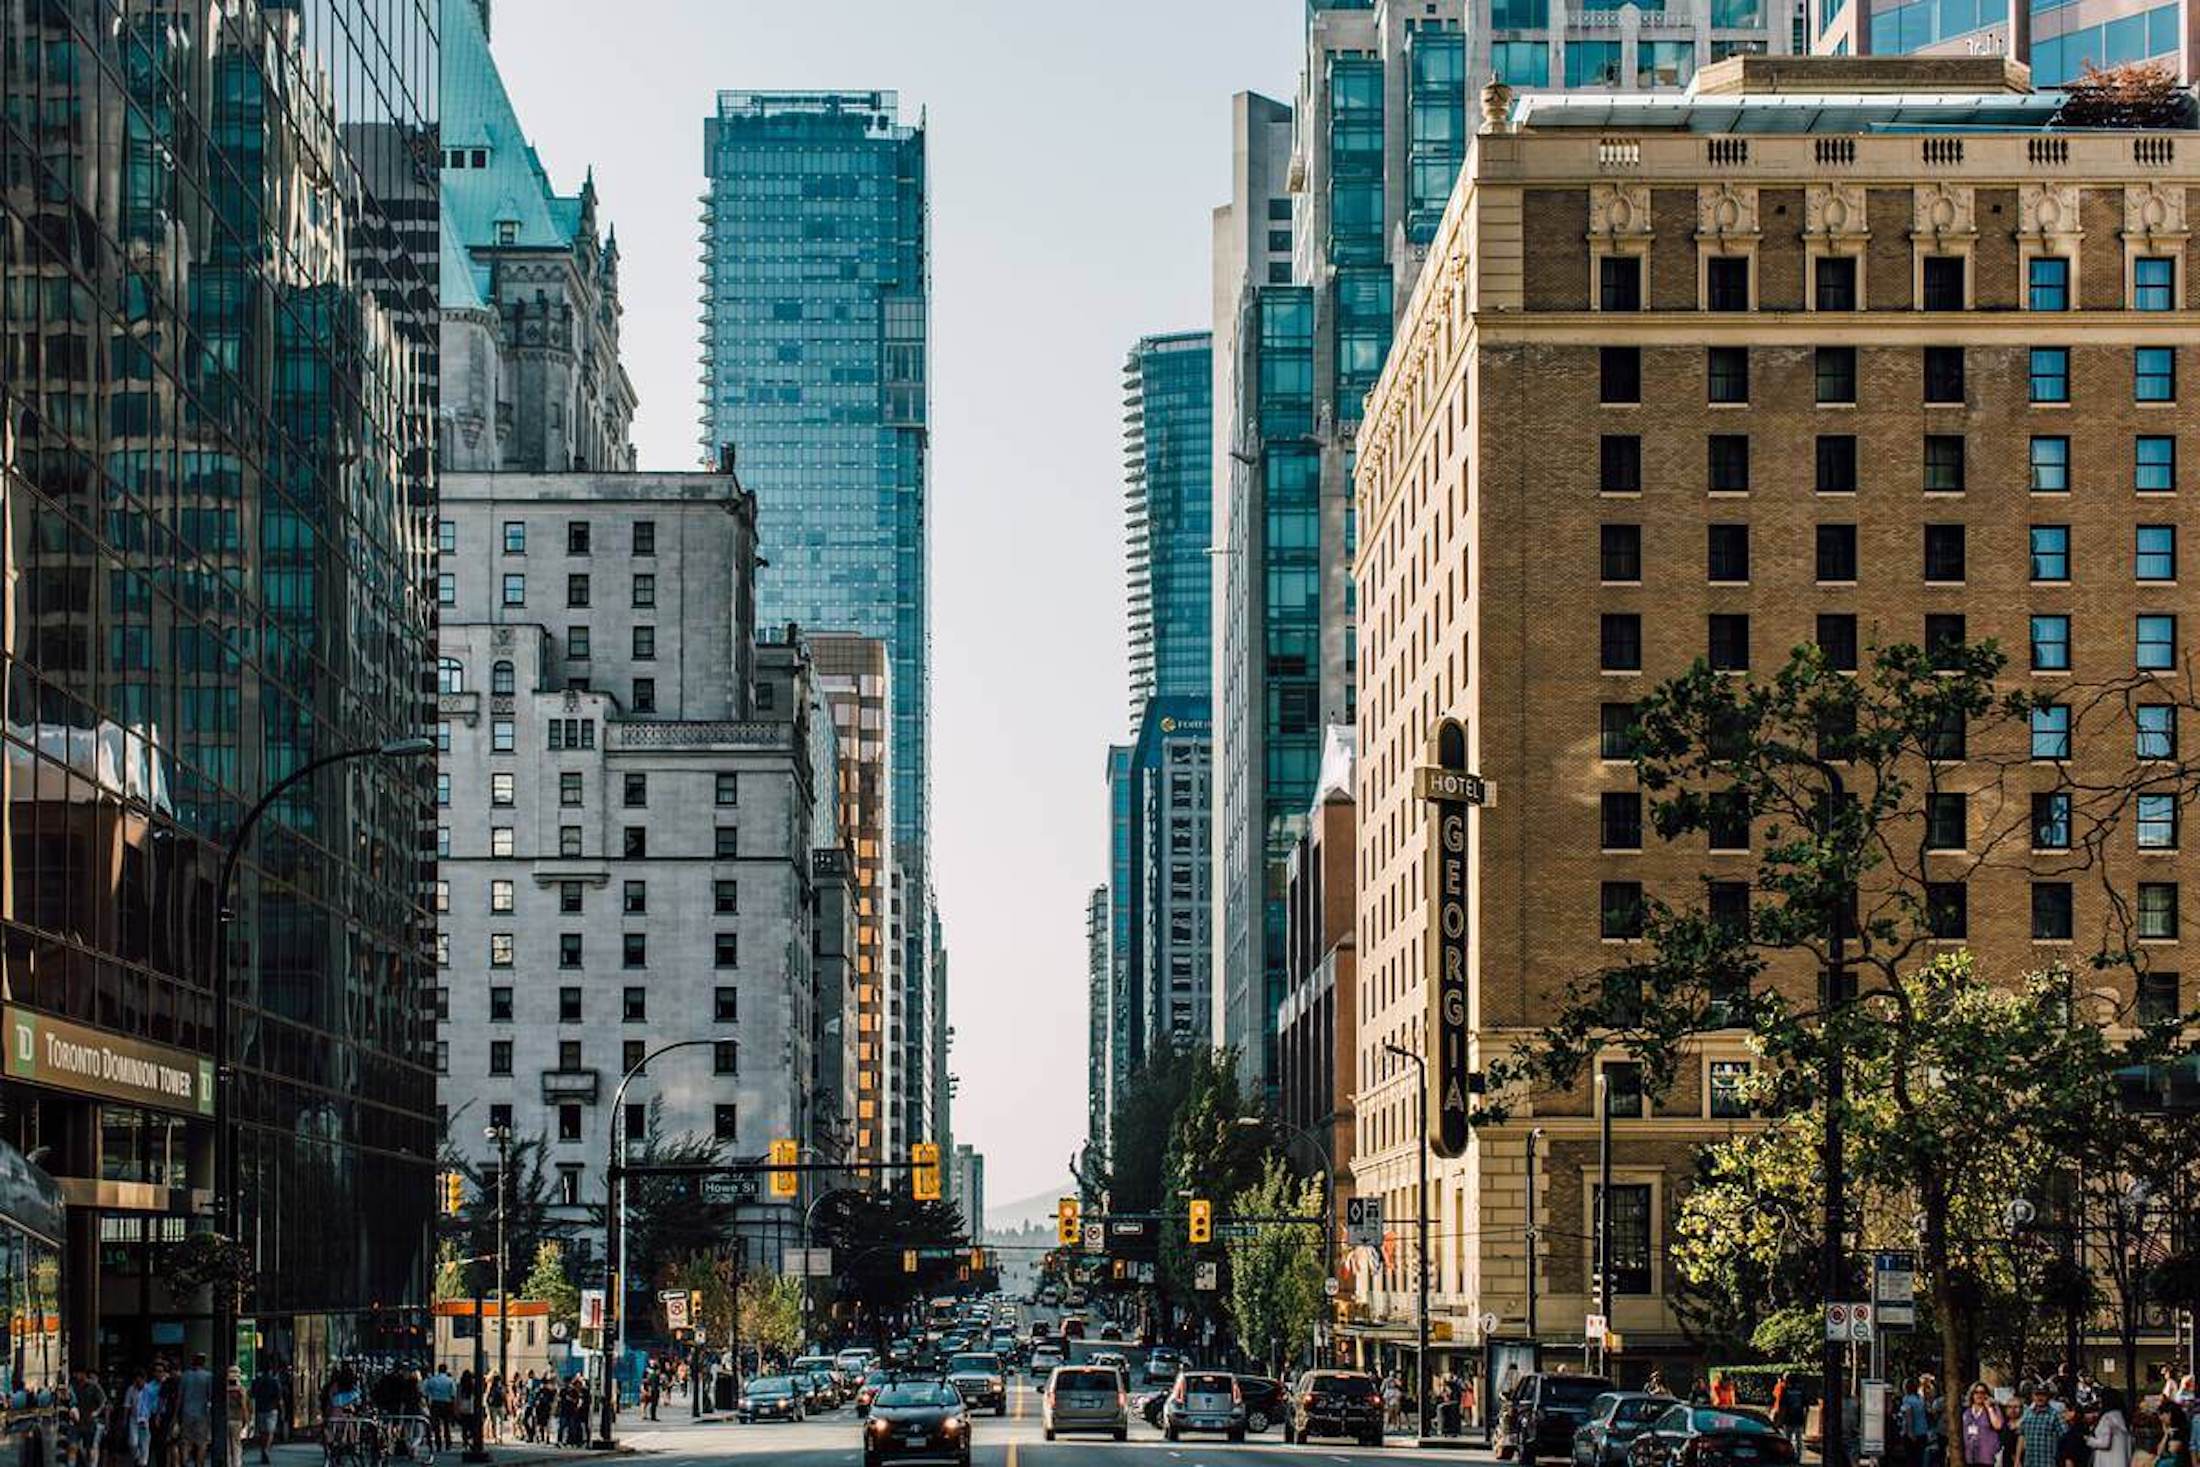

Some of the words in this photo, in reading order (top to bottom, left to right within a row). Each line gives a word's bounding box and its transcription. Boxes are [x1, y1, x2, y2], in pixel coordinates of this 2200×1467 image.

[1430, 773, 1480, 799] HOTEL
[1442, 814, 1465, 1113] GEORGIA
[15, 1024, 33, 1061] TD
[45, 1031, 101, 1078] TORONTO
[102, 1048, 158, 1090] DOMINION
[159, 1066, 192, 1097] TOWER
[200, 1071, 212, 1101] TD
[705, 1182, 738, 1193] Howe
[742, 1182, 755, 1193] St
